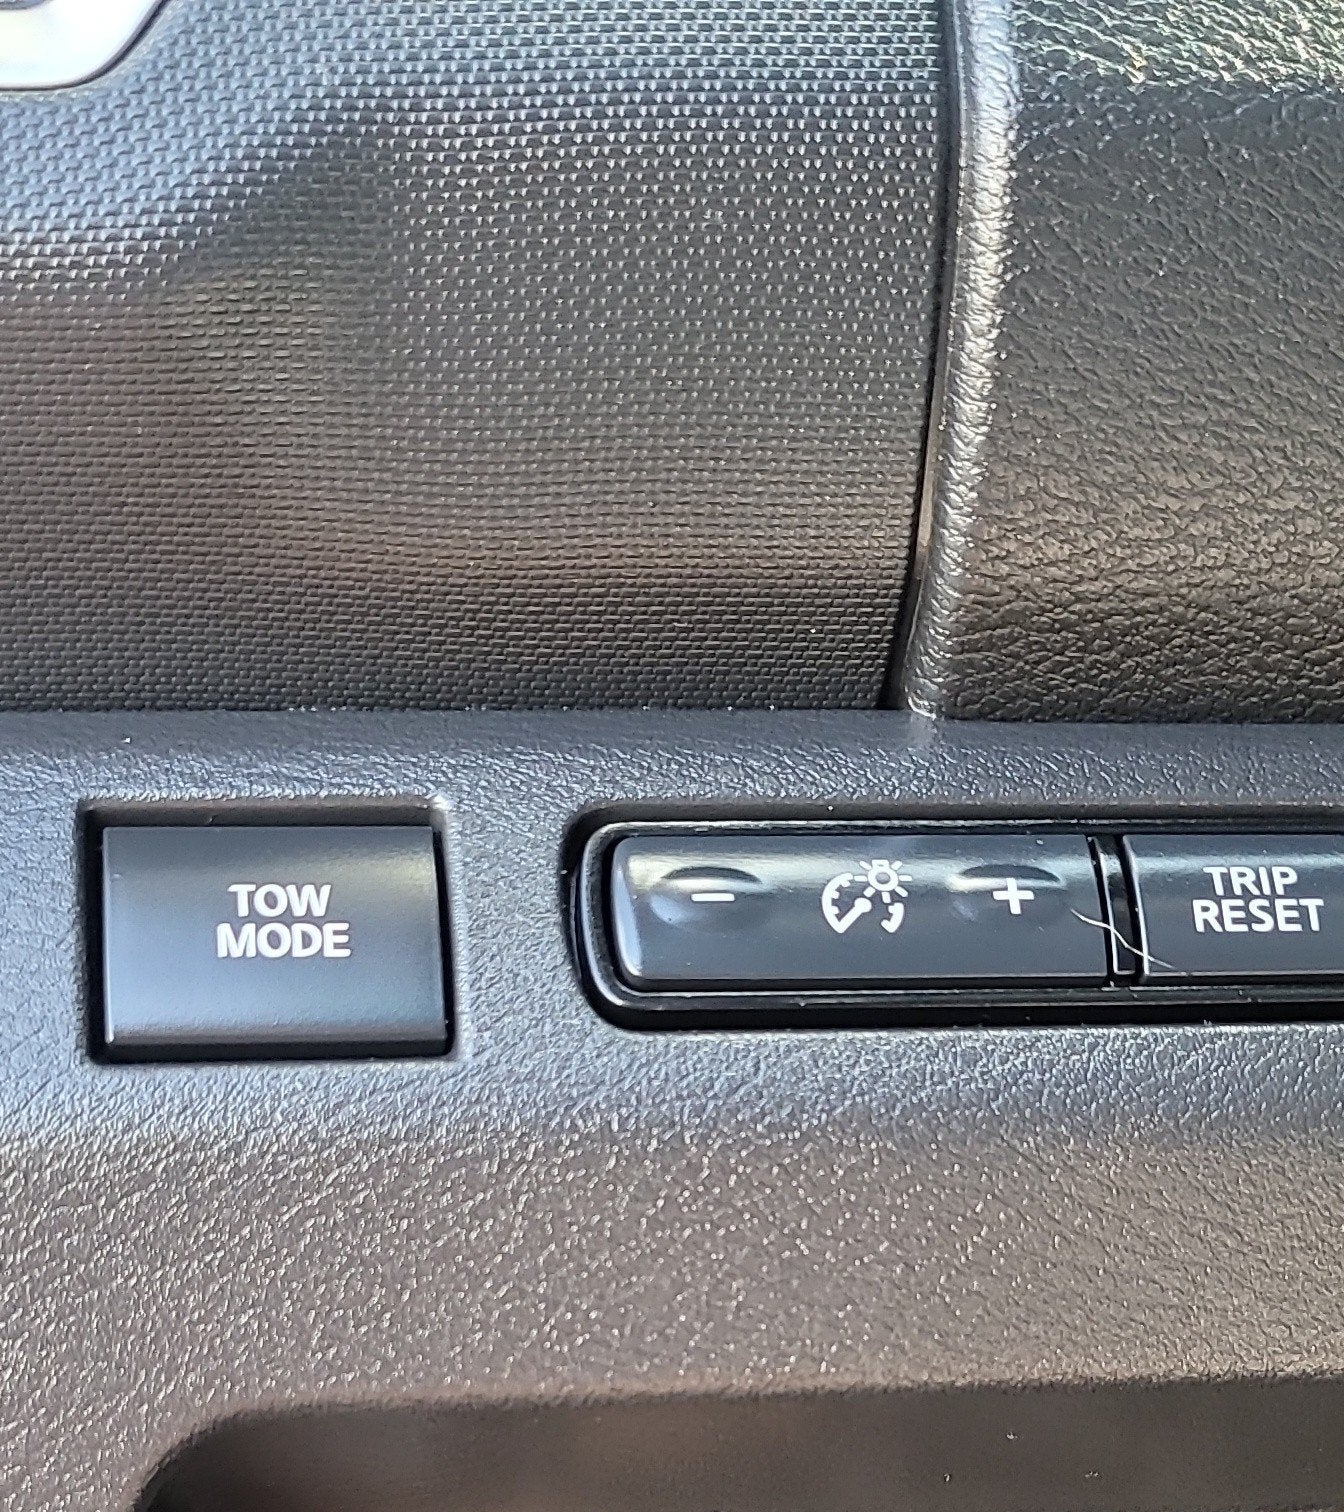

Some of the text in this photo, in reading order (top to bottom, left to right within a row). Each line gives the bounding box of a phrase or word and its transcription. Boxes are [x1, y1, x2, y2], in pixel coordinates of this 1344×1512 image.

[1202, 865, 1299, 897] TRIP
[228, 883, 332, 918] TOW
[1191, 897, 1324, 934] RESET
[216, 922, 352, 959] MODE
